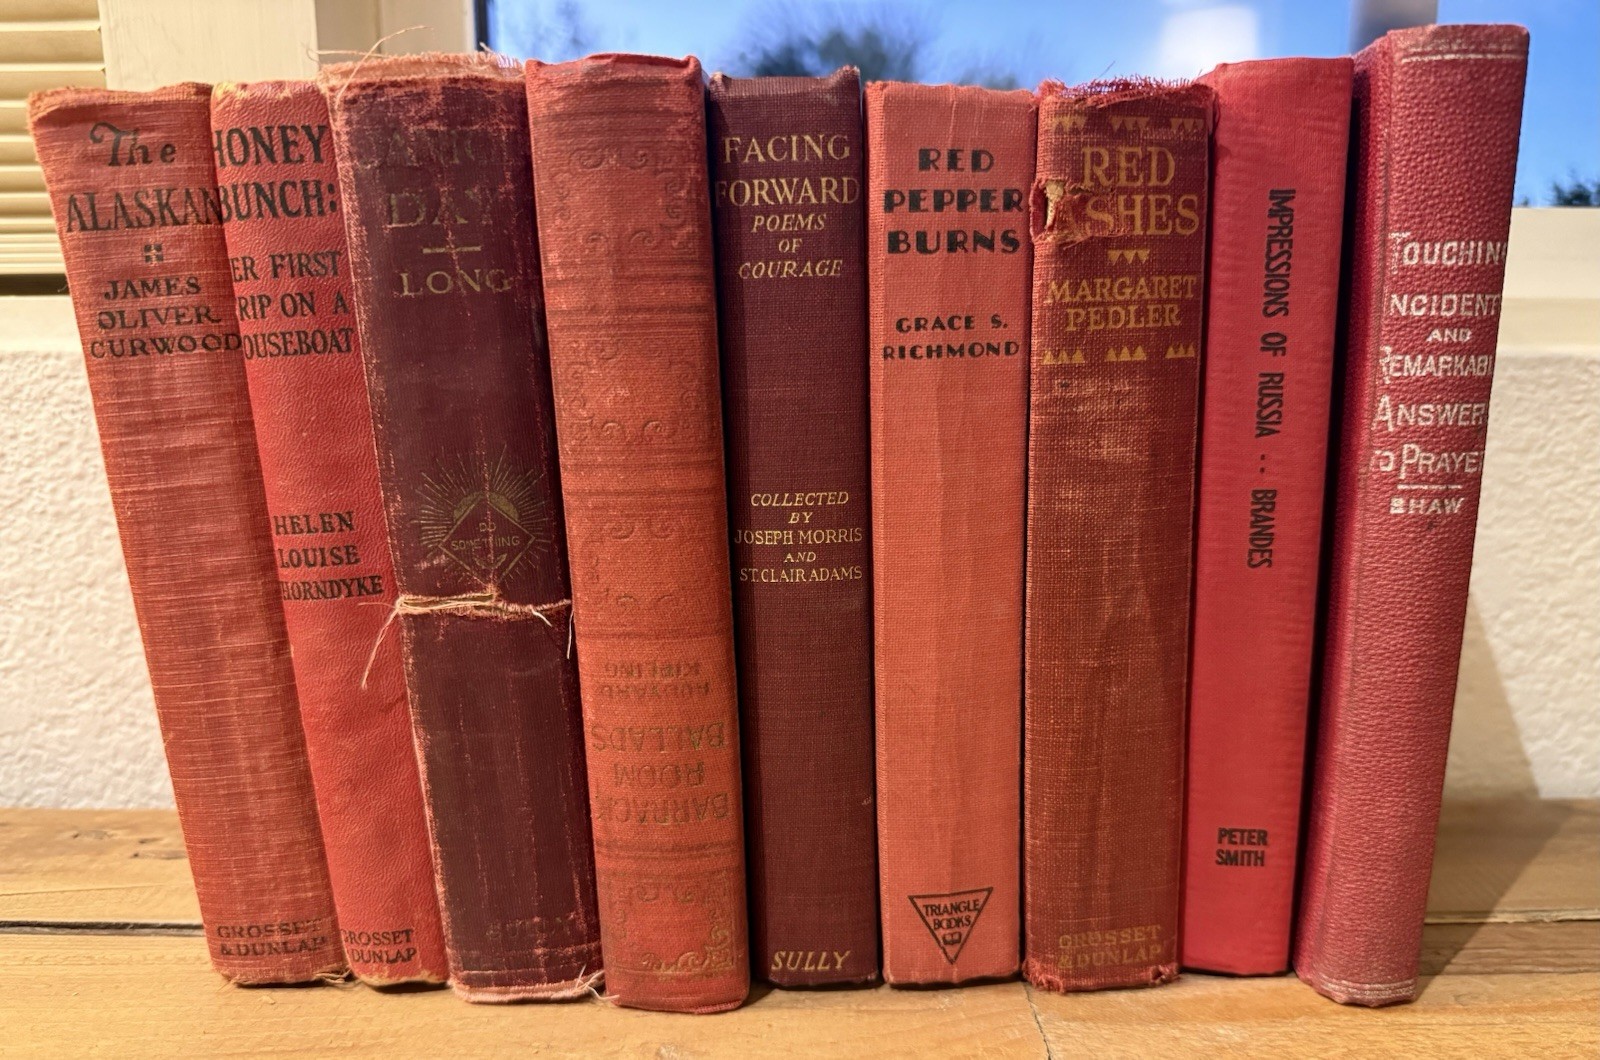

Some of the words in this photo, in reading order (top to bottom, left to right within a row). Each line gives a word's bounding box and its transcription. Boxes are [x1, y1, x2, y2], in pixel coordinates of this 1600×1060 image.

[89, 121, 177, 167] The
[723, 134, 851, 163] FACING
[918, 148, 995, 174] RED
[1081, 146, 1176, 188] RED
[715, 176, 861, 207] FORWARD
[883, 188, 1024, 213] PEPPER
[66, 187, 224, 233] ALASKAN
[751, 213, 828, 233] POEMS
[1062, 193, 1199, 237] SHES
[778, 238, 802, 254] OF
[887, 229, 1021, 255] BURNS
[1262, 188, 1297, 319] IMPRESSIONS
[230, 256, 259, 282] ER
[268, 250, 342, 279] FIRST
[739, 259, 844, 279] COURAGE
[104, 277, 201, 300] JAMES
[398, 269, 514, 297] LONG
[1044, 274, 1198, 304] MARGARET
[97, 307, 222, 330] OLIVER
[237, 294, 272, 321] RIP
[280, 290, 317, 318] ON
[333, 290, 350, 315] A
[1065, 303, 1182, 332] PEDLER
[895, 315, 975, 333] GRACE
[990, 314, 1009, 330] S.
[1426, 327, 1473, 343] AND
[90, 333, 242, 359] CURWOOD
[242, 327, 355, 360] OUSEBOAT
[883, 341, 1020, 360] RICHMOND
[1260, 332, 1288, 358] OF
[1254, 372, 1285, 439] RUSSIA
[1371, 394, 1487, 432] ANSWER
[1399, 442, 1484, 480] PRAYE
[750, 491, 849, 507] COLLECTED
[1389, 496, 1465, 515] SHAW
[273, 511, 355, 535] HELEN
[788, 512, 814, 524] BY
[1246, 489, 1278, 570] BRANDES
[734, 529, 794, 545] JOSEPH
[799, 527, 863, 545] MORRIS
[278, 545, 361, 568] LOUISE
[784, 551, 817, 563] AND
[281, 575, 384, 601] HORNDYKE
[591, 721, 725, 751] BALLADS
[1217, 827, 1269, 847] PETER
[1215, 848, 1265, 867] SMITH
[923, 899, 980, 917] TRIANGLE
[216, 918, 325, 939] GROSSET
[933, 915, 972, 930] BOOKS
[771, 950, 851, 971] SULLY
